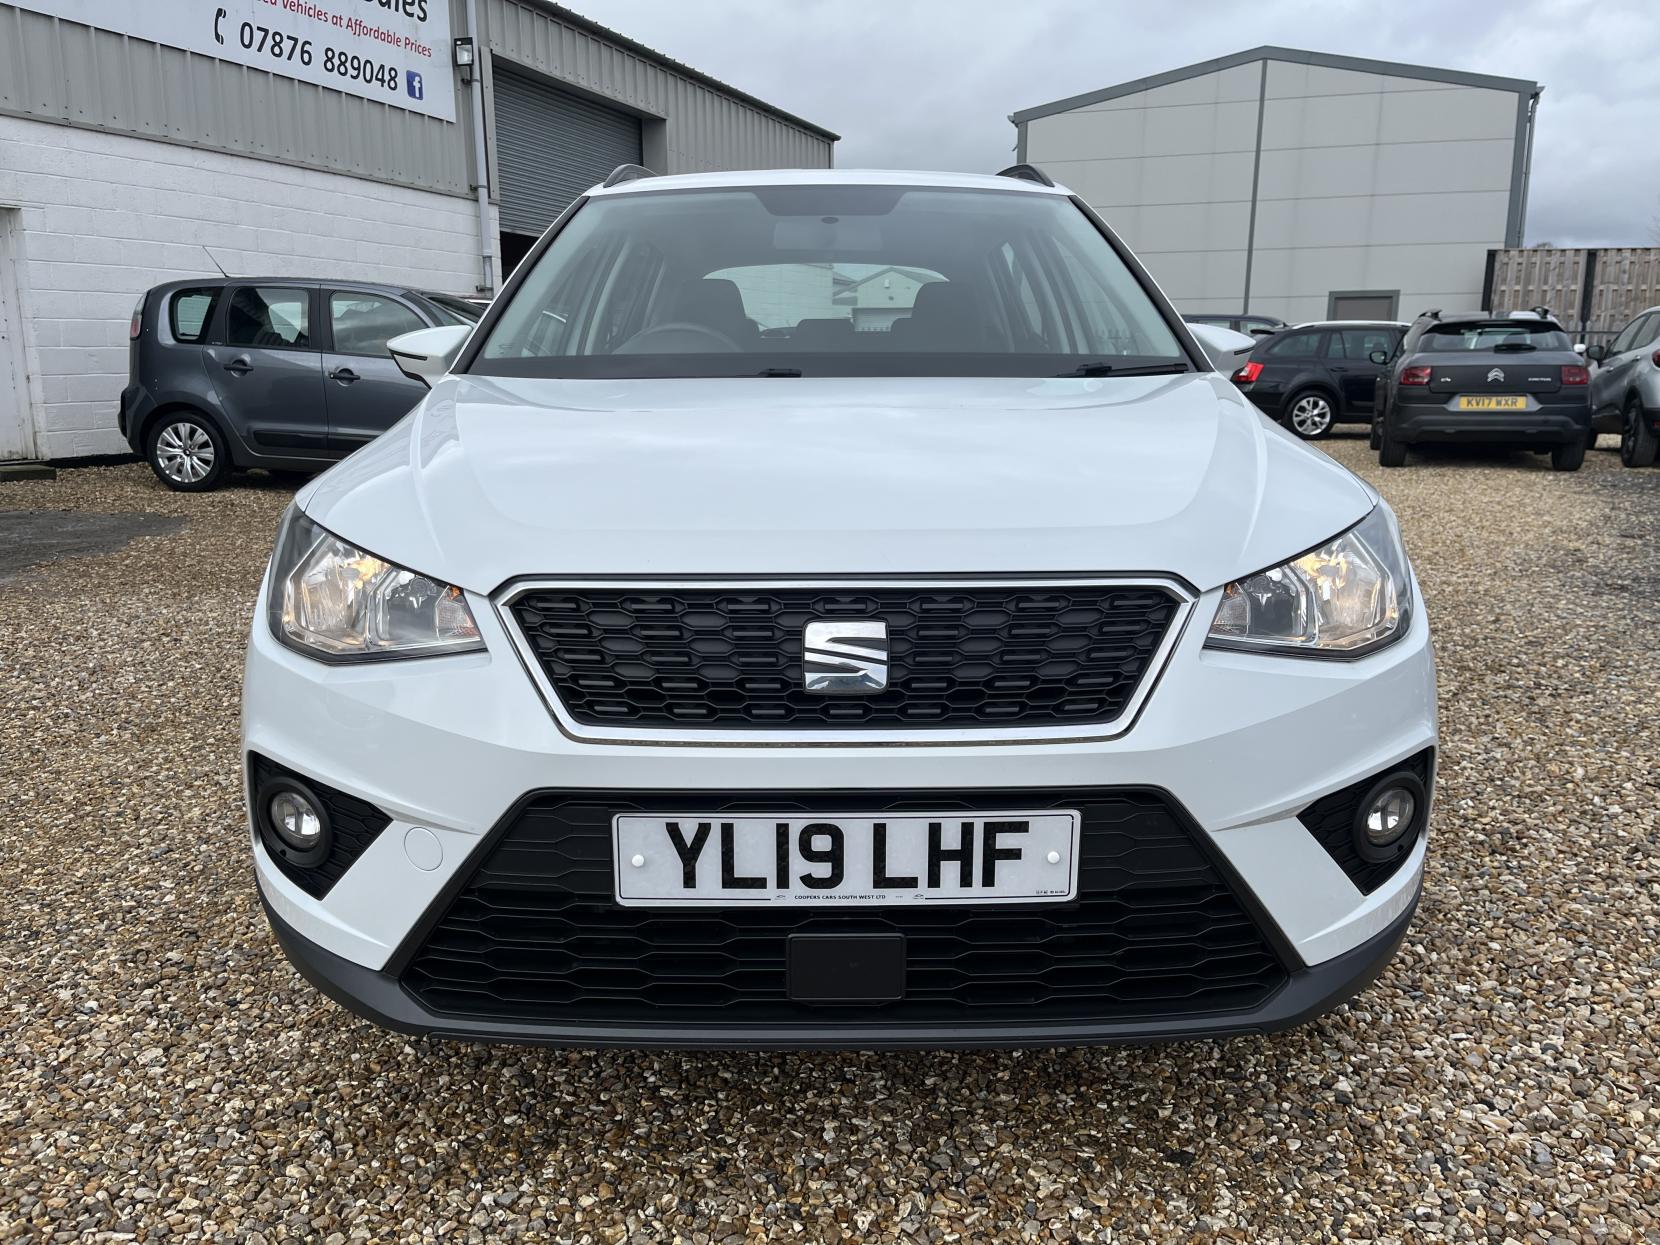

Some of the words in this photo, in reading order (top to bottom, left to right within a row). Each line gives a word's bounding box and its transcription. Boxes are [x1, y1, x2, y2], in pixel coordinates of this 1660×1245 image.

[239, 21, 313, 66] 07876
[323, 47, 398, 91] 889048
[331, 14, 343, 28] at
[345, 17, 402, 48] Affordable
[404, 36, 432, 58] Prices
[1466, 398, 1492, 408] KV17
[1496, 398, 1518, 408] WXR
[665, 822, 845, 890] YL19
[872, 821, 1030, 889] LHF
